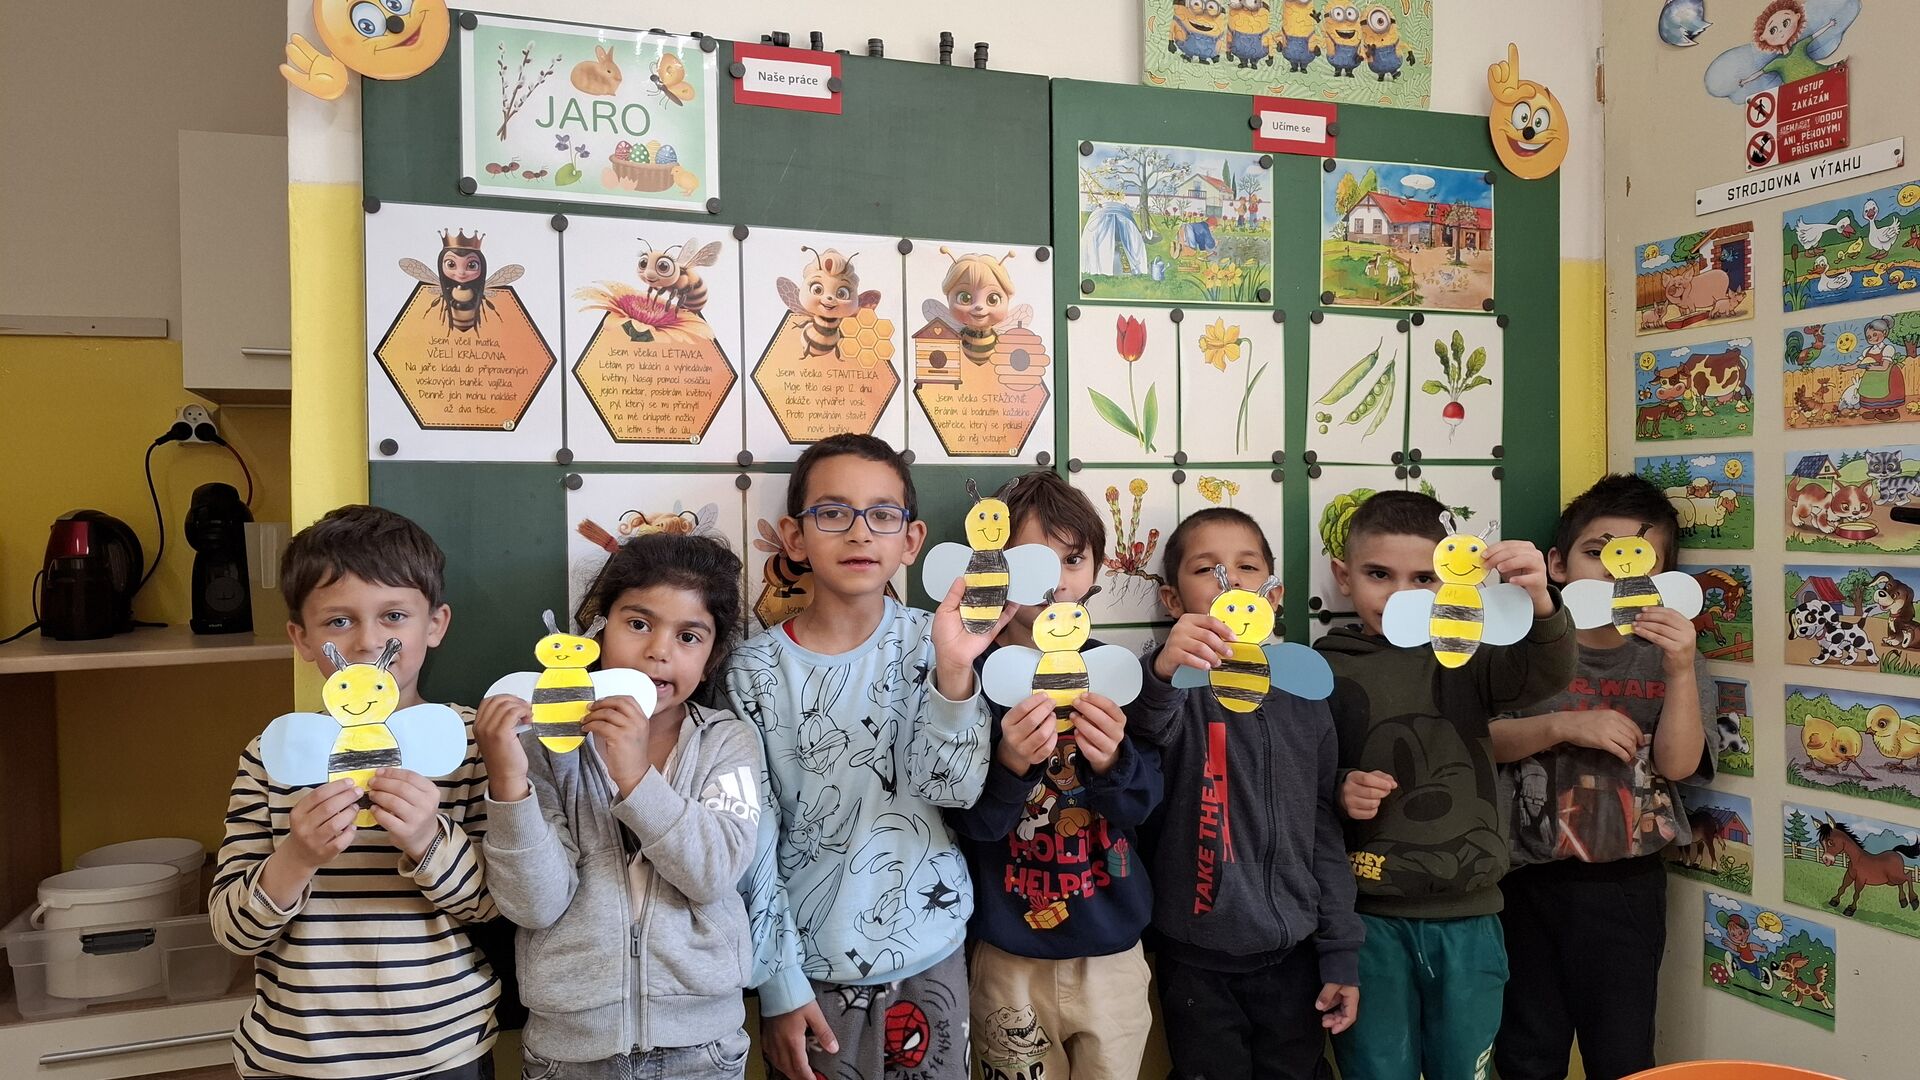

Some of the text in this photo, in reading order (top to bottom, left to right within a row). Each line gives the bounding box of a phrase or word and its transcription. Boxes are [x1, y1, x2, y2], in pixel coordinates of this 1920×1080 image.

[758, 71, 818, 86] Naše práce
[1799, 80, 1823, 94] VSTUP
[1792, 91, 1829, 111] ZAKÁZÁN
[535, 95, 651, 137] JARO
[1272, 121, 1300, 132] Učíme
[1784, 135, 1795, 145] ANI
[1792, 138, 1832, 156] PŘÍSTROJI
[1727, 155, 1862, 201] STROJOVNA VÝTAHU
[428, 336, 449, 345] Jsem
[427, 348, 453, 359] VČELÍ
[608, 347, 628, 357] Jsem
[405, 362, 417, 371] Na
[442, 363, 460, 372] kladu
[465, 364, 474, 372] do
[626, 363, 634, 371] po
[776, 368, 795, 377] Jsem
[835, 385, 844, 395] po
[936, 393, 953, 402] Jsem
[458, 404, 471, 413] dva
[1599, 678, 1665, 700] WAR
[1200, 785, 1220, 840] THE
[1194, 846, 1216, 914] TAKE
